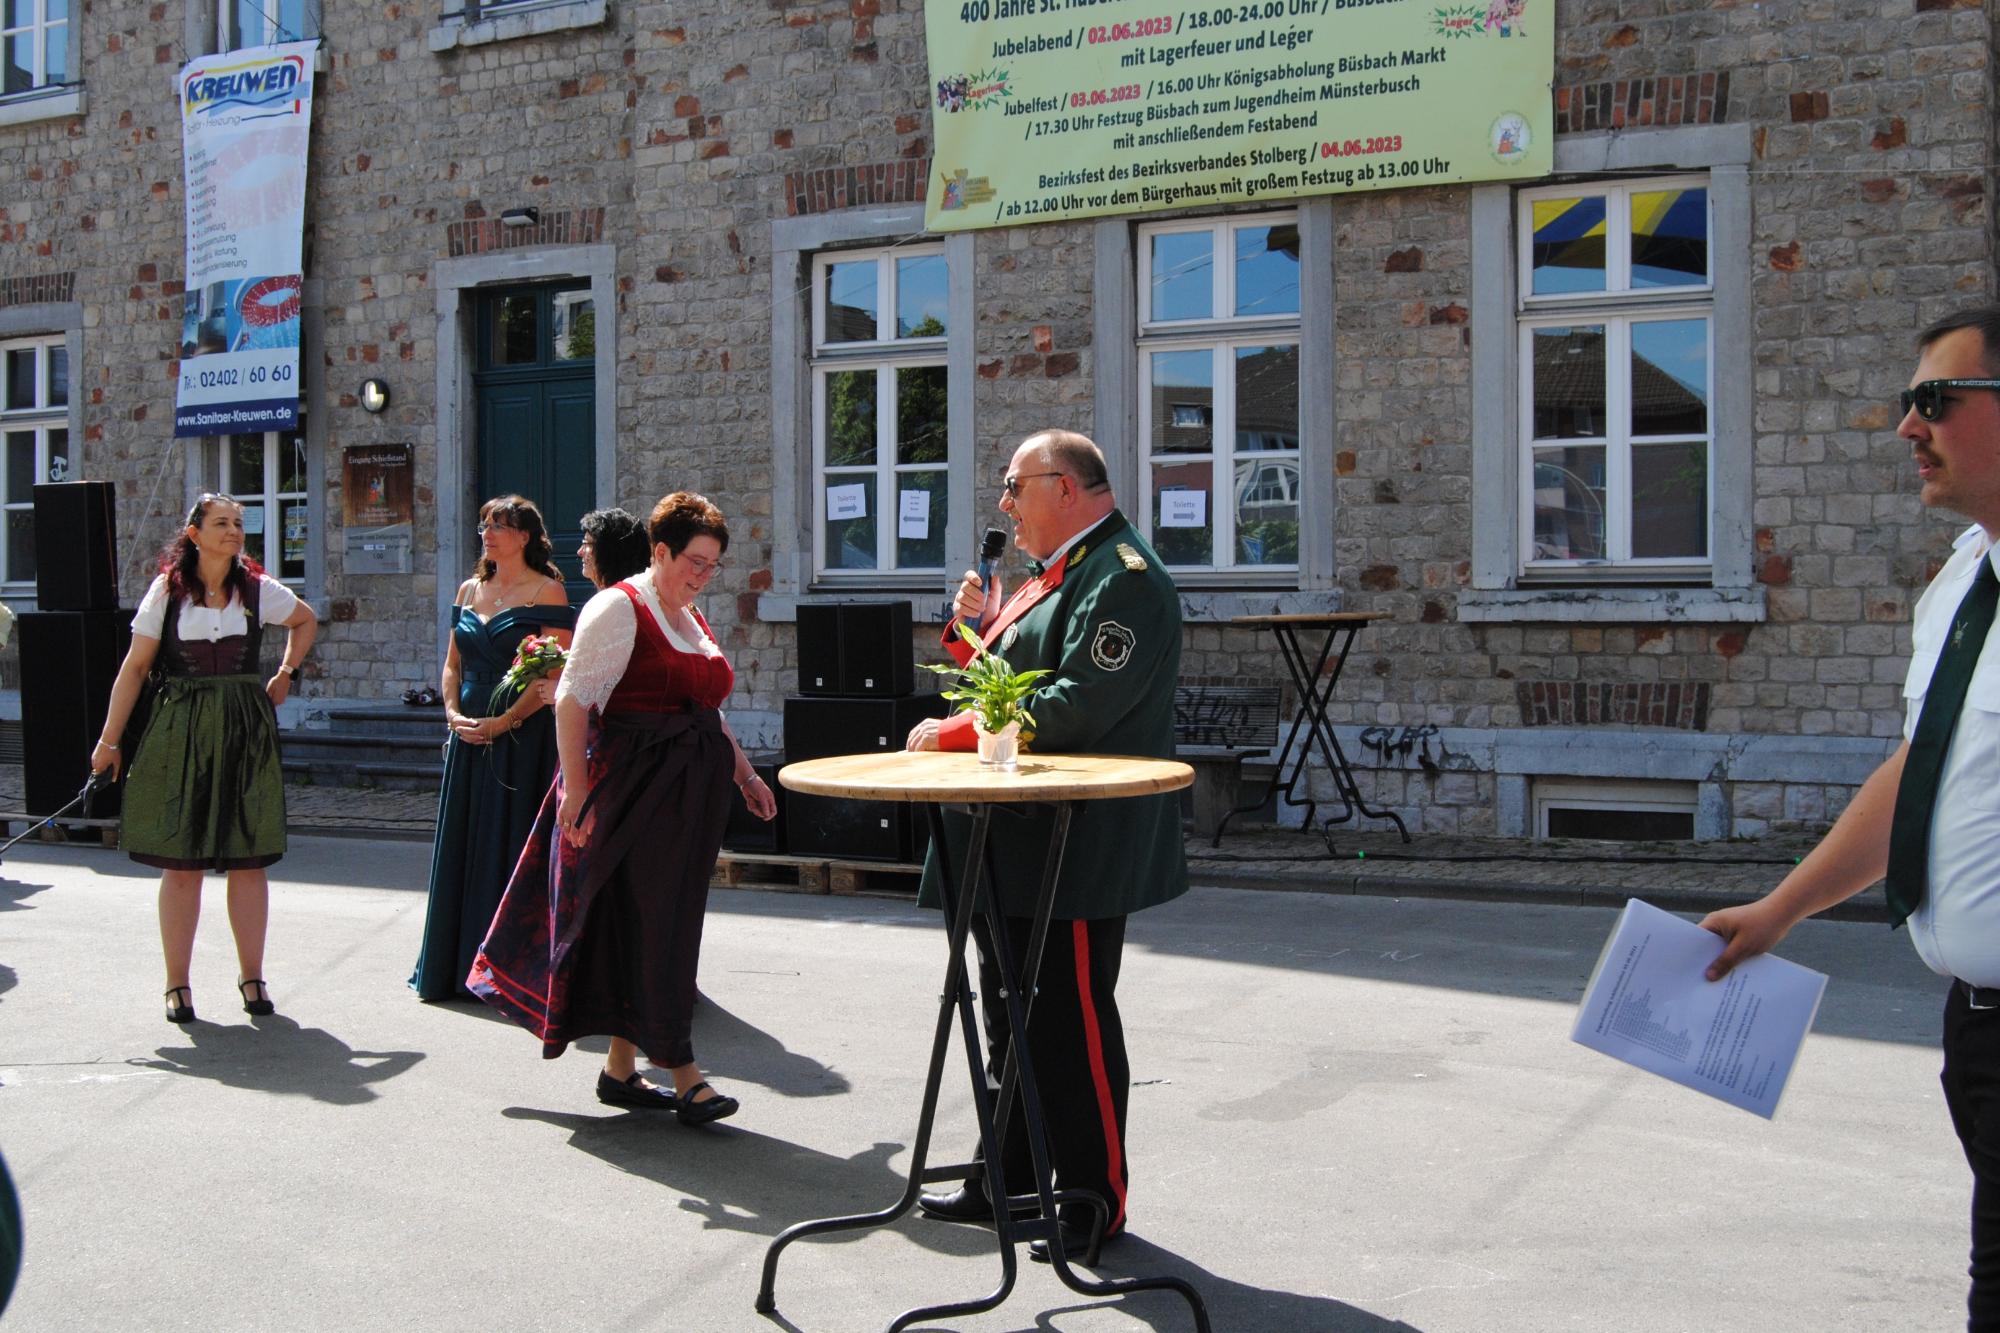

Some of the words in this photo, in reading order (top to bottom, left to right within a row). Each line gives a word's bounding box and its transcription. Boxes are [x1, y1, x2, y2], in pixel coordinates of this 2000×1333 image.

[961, 0, 989, 23] 400
[993, 29, 1072, 58] Jubelabend
[1076, 27, 1084, 49] /
[1088, 16, 1172, 44] 02.06.2023
[1176, 12, 1185, 35] /
[1189, 1, 1284, 29] 18.00-24.00
[1289, 0, 1318, 15] Uhr
[1121, 48, 1145, 67] mit
[1150, 38, 1232, 66] Lagerfeuer
[1235, 31, 1266, 53] und
[1004, 97, 1058, 116] Jubelfest
[1061, 93, 1068, 112] /
[1070, 84, 1141, 109] 03.06.2023
[1146, 81, 1155, 101] /
[1157, 79, 1194, 96] 16.00
[1197, 73, 1220, 91] Uhr
[1224, 60, 1335, 87] Königsabholung
[1338, 51, 1397, 73] Büsbach
[1401, 47, 1446, 66] Markt
[1025, 121, 1032, 140] /
[1035, 118, 1069, 136] 17.30
[1072, 114, 1094, 131] Uhr
[1097, 109, 1143, 127] Festzug
[1146, 99, 1200, 121] Büsbach
[1203, 101, 1231, 114] zum
[1234, 86, 1316, 113] Jugendheim
[1320, 75, 1420, 100] Münsterbusch
[1113, 132, 1134, 150] mit
[1138, 122, 1244, 146] anschließendem
[1248, 111, 1318, 133] Festabend
[1038, 168, 1104, 189] Bezirksfest
[1108, 167, 1129, 181] des
[1132, 152, 1247, 178] Bezirksverbandes
[1250, 146, 1307, 165] Stolberg
[1310, 142, 1318, 162] /
[1321, 135, 1402, 159] 04.06.2023
[996, 202, 1003, 220] /
[1006, 201, 1021, 217] ab
[1024, 199, 1058, 215] 12.00
[1061, 194, 1084, 211] Uhr
[1087, 195, 1107, 208] vor
[1110, 190, 1139, 206] dem
[1142, 180, 1217, 204] Bürgerhaus
[1220, 178, 1243, 194] mit
[1246, 173, 1298, 196] großem
[1301, 168, 1354, 187] Festzug
[1357, 164, 1374, 180] ab
[1378, 161, 1419, 179] 13.00
[1423, 157, 1450, 174] Uhr
[200, 368, 238, 387] 02402
[250, 366, 266, 383] 60
[272, 364, 291, 381] 60
[177, 407, 292, 427] www.Sanitaer-Kreuwen.de
